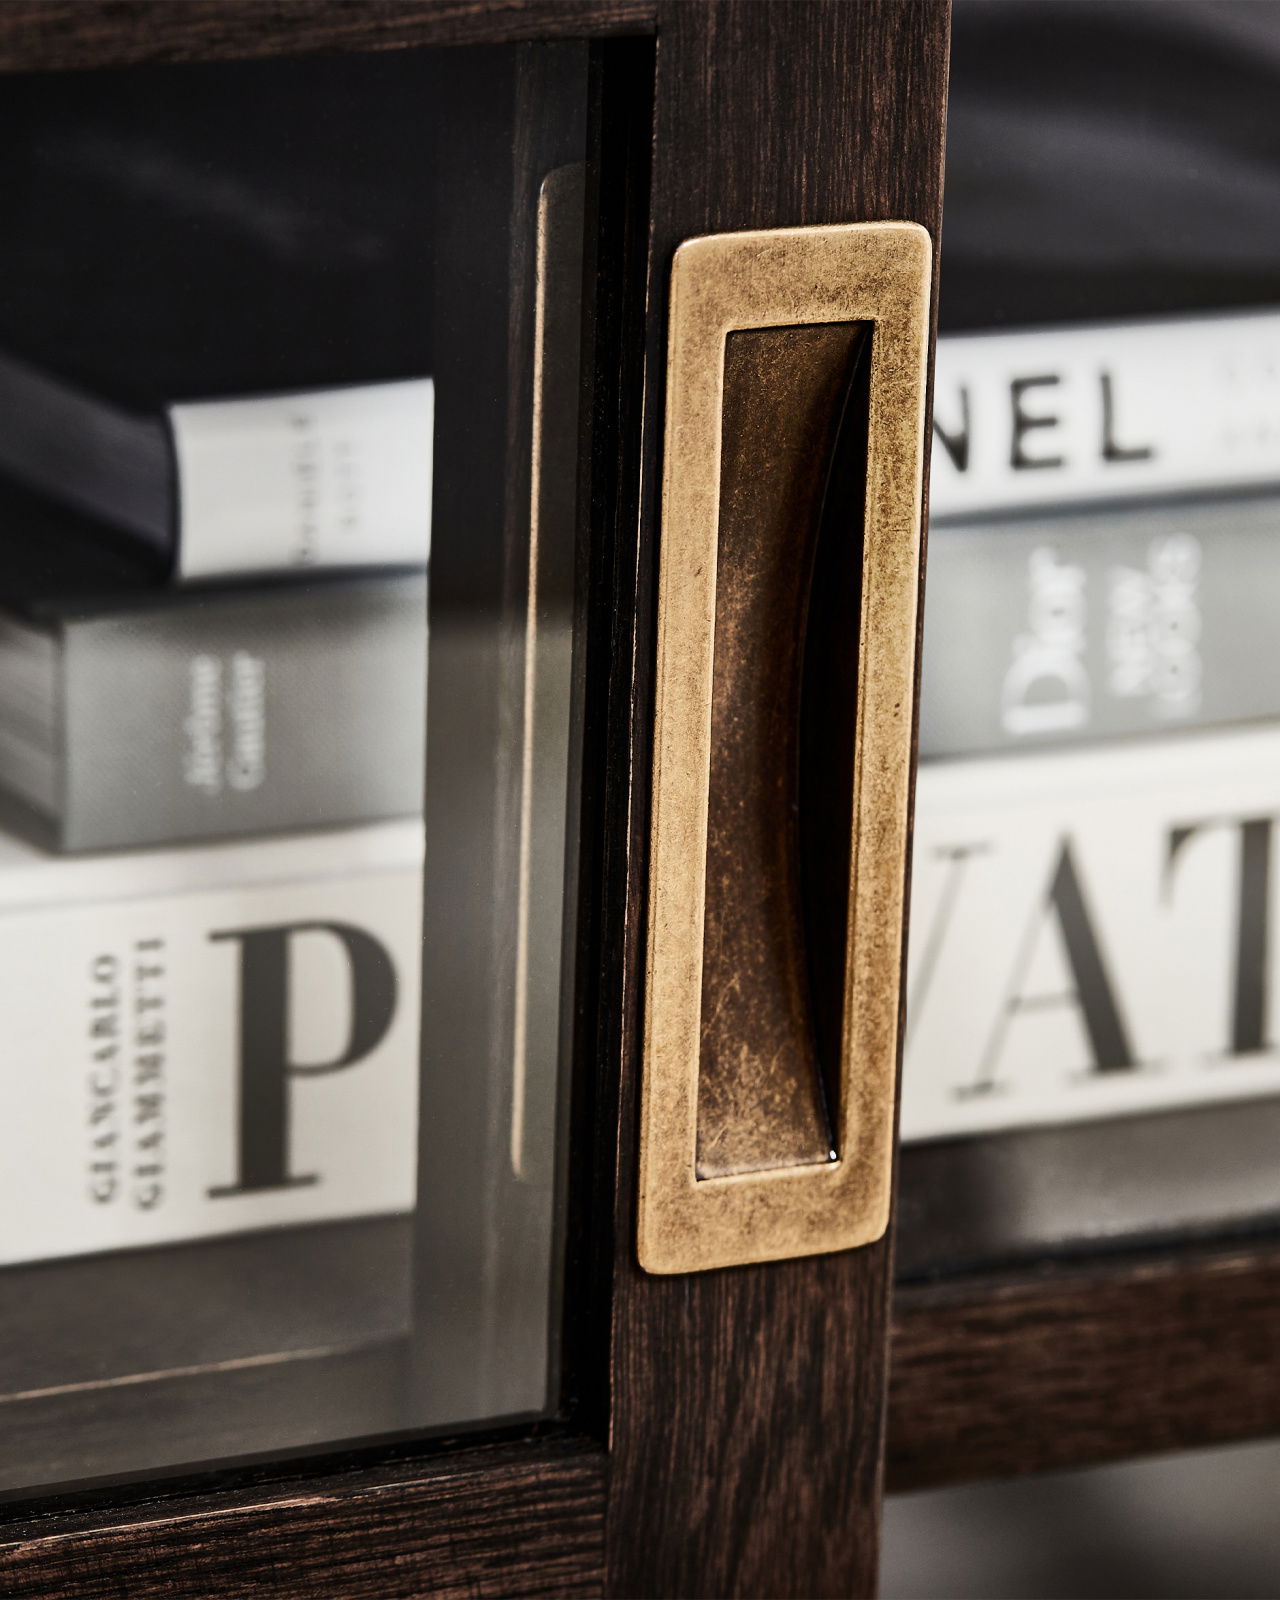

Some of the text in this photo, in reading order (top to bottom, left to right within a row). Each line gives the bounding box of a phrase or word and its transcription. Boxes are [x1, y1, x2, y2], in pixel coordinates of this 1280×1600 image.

[934, 367, 1155, 474] NEL
[1002, 547, 1088, 736] Dior
[88, 953, 121, 1205] GIANCARLO
[133, 936, 167, 1210] GIAMMETTI
